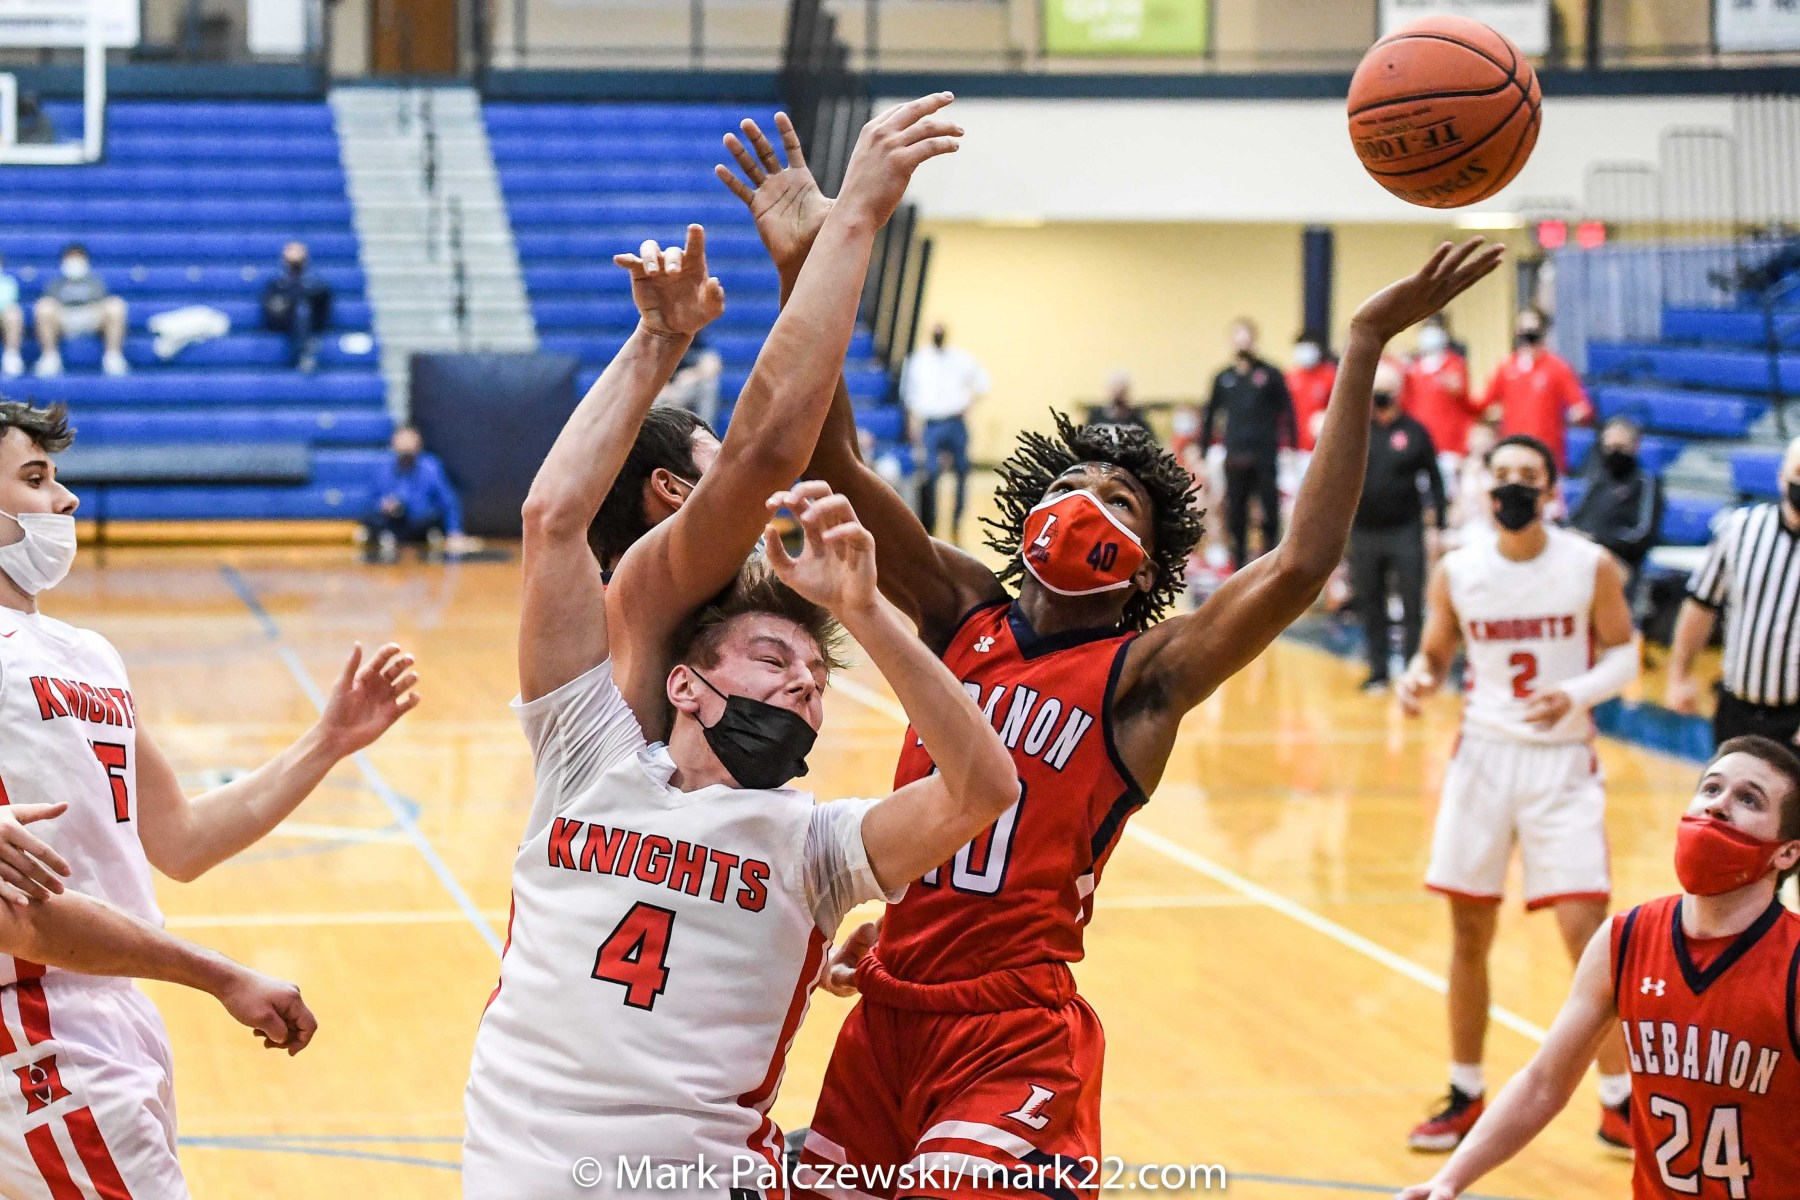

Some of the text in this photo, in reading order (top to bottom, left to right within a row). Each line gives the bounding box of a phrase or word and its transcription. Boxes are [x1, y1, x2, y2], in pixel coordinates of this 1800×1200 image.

[1086, 541, 1118, 573] 40
[1509, 652, 1538, 699] 2
[548, 817, 770, 913] KNIGHTS
[591, 901, 676, 1012] 4
[1622, 1020, 1780, 1095] LEBANON
[1650, 1093, 1754, 1200] 24
